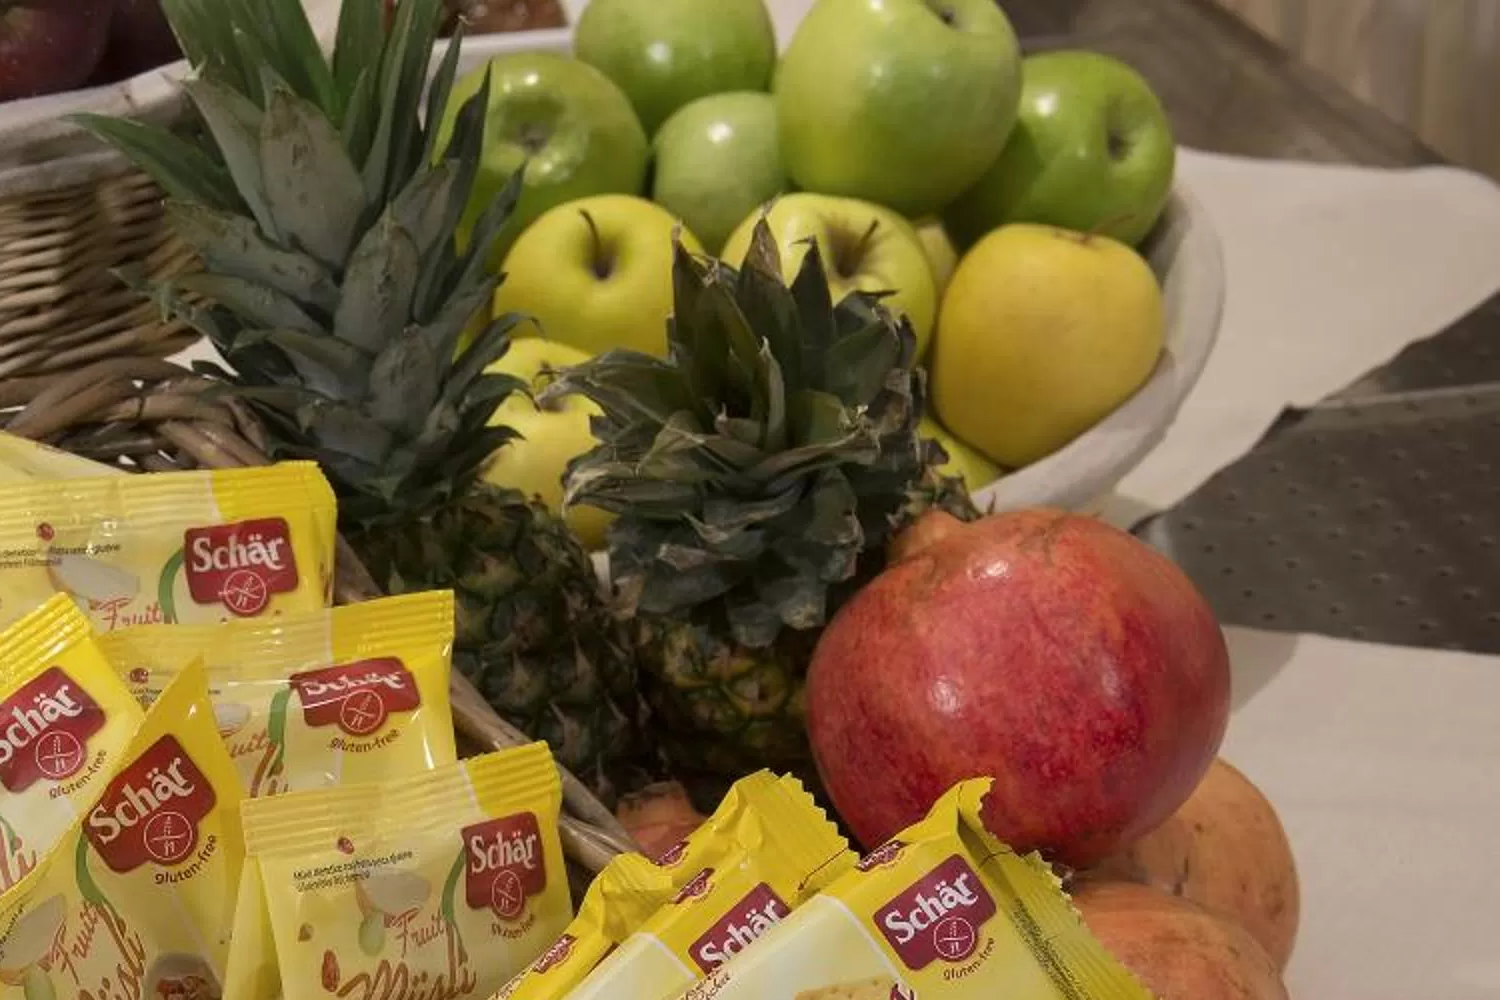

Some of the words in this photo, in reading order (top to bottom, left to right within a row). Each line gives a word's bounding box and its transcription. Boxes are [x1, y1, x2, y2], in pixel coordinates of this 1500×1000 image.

[192, 533, 285, 573] Schär
[90, 597, 161, 630] Fruit
[50, 749, 108, 799] gluten-free
[89, 757, 195, 844] Schär
[155, 834, 217, 884] gluten-free
[471, 832, 539, 874] Schär
[395, 906, 447, 958] Fruit
[699, 899, 787, 966] Schär
[885, 872, 978, 945] Schär
[52, 900, 100, 983] Fruit
[943, 936, 996, 982] gluten-free
